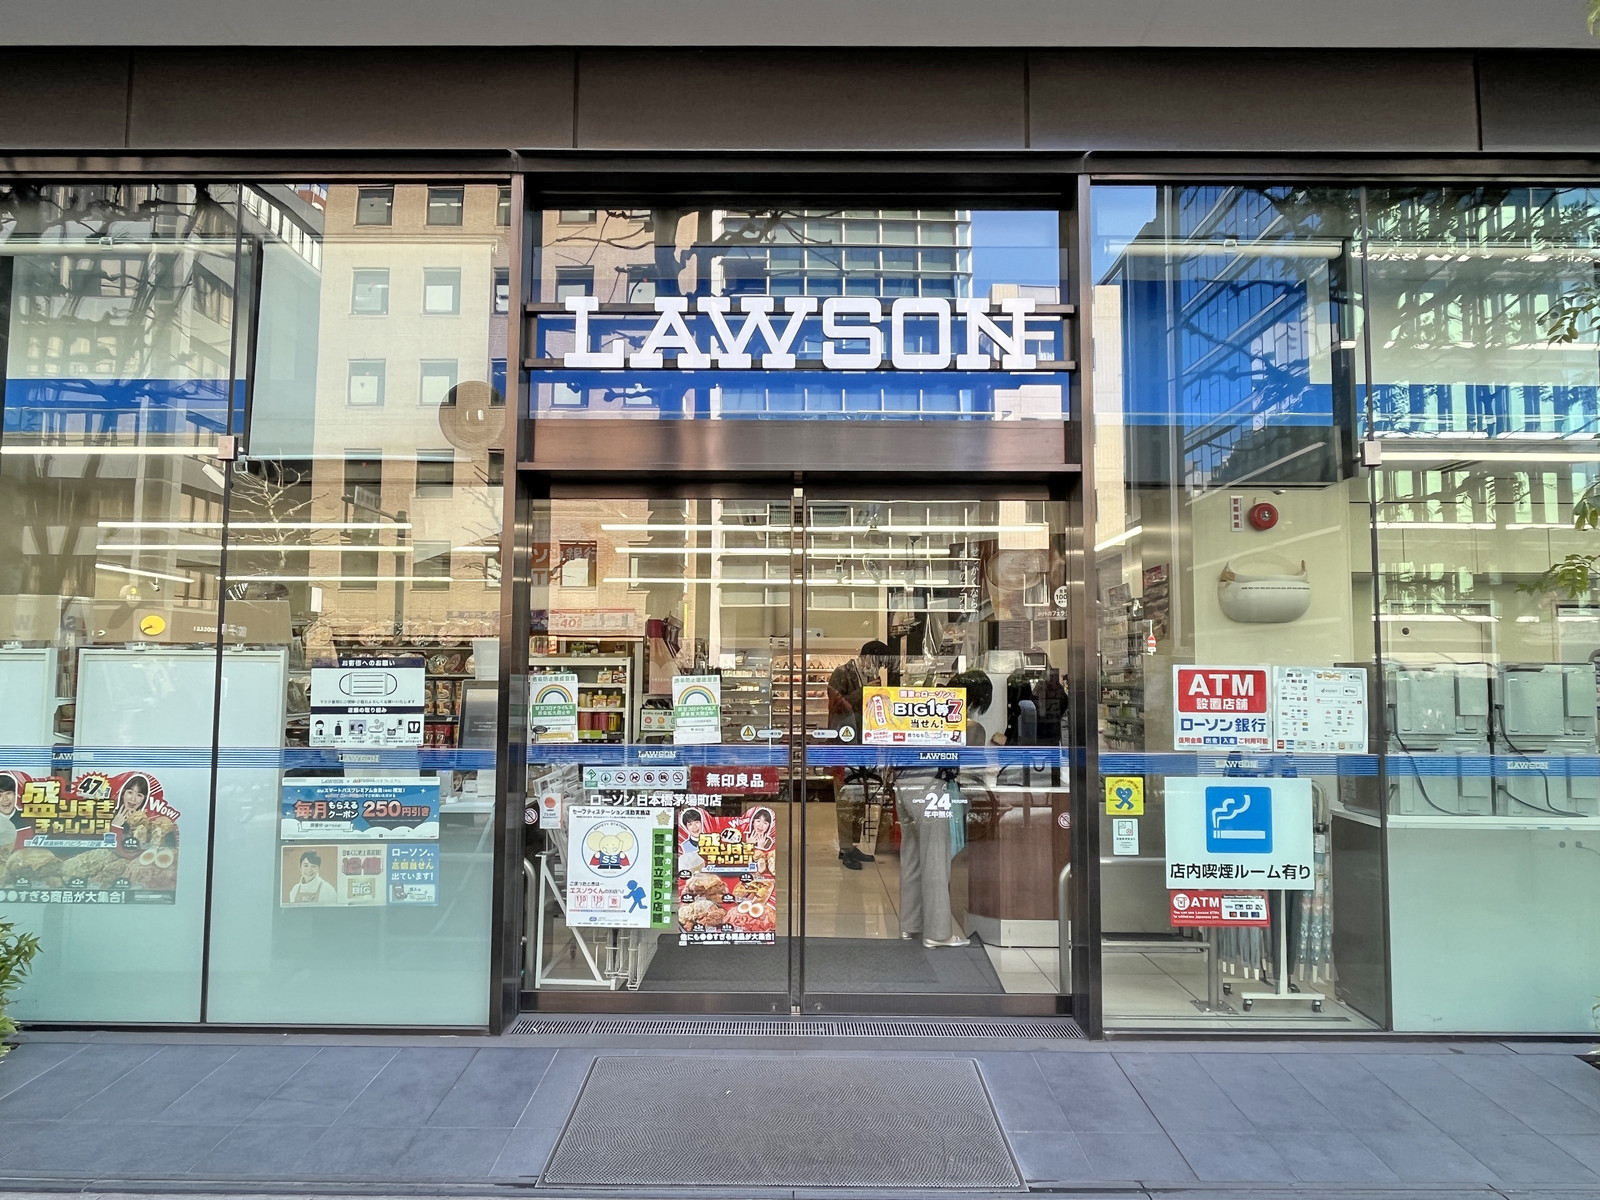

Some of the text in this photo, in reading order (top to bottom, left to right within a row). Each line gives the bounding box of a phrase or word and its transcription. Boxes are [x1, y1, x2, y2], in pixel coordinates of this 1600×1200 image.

[563, 296, 1036, 369] LAWSON
[1188, 673, 1254, 696] ATM
[1196, 697, 1248, 710] 設置店舗
[1180, 718, 1266, 732] ローソン銀行
[638, 750, 677, 759] LAWSON
[919, 752, 959, 760] LAWSON
[1506, 761, 1549, 770] LAWSON
[706, 773, 765, 788] 無印良品
[20, 781, 115, 818] 盛りすぎ
[328, 801, 358, 810] もらえる
[590, 794, 722, 807] ローソン日本橋茅場町店
[925, 793, 950, 811] 24
[294, 800, 430, 819] 毎月 250円引き
[328, 811, 358, 819] クーポン
[923, 810, 953, 819] 年中無休
[34, 818, 112, 834] チャレンジ
[602, 855, 618, 864] SS
[391, 872, 434, 881] 出ています!
[1170, 863, 1311, 880] 店内喫煙ルーム有り
[1191, 897, 1220, 908] ATM
